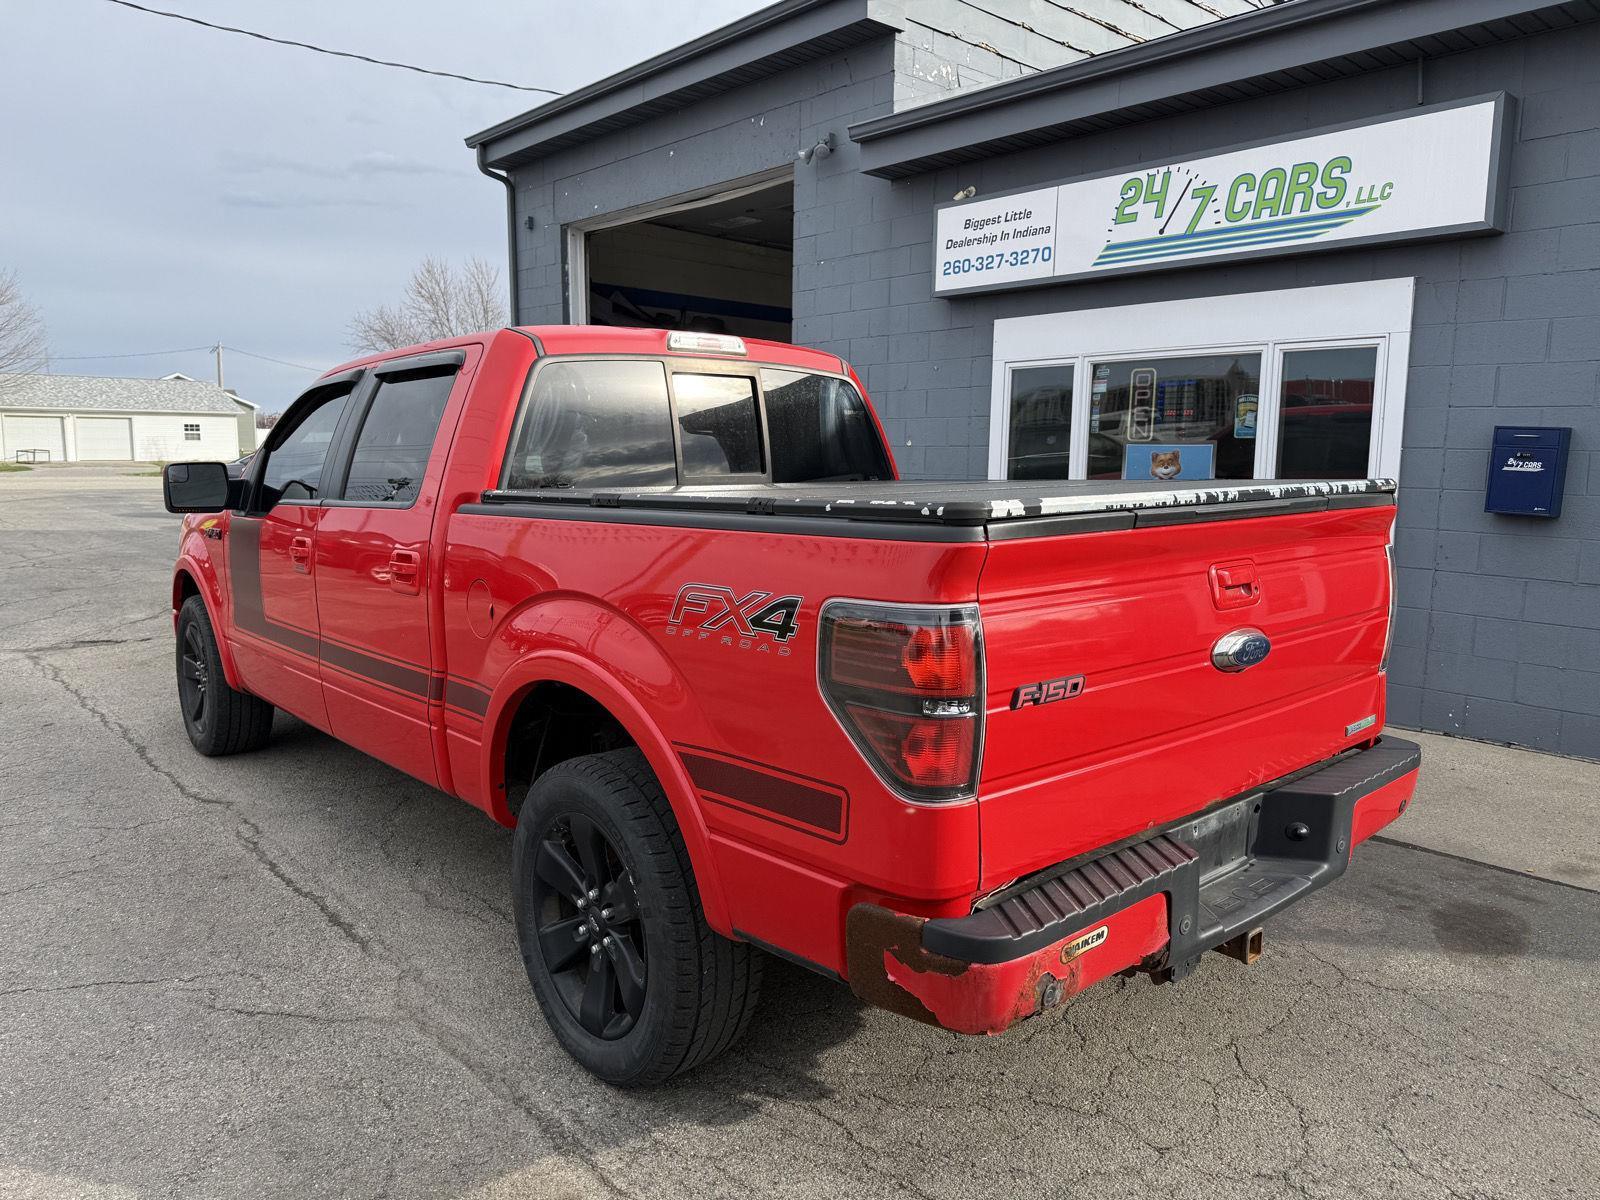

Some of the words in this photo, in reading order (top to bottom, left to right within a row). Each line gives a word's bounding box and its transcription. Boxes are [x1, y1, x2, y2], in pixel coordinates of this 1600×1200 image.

[1354, 181, 1394, 205] LLC
[963, 215, 1002, 231] Biggest
[1004, 208, 1033, 223] Little
[945, 232, 998, 250] Dealership
[1000, 230, 1010, 241] In
[1012, 225, 1051, 240] Indiana
[943, 246, 1052, 276] 260-327-3270
[1133, 373, 1152, 438] OPEN
[667, 582, 804, 644] FX4
[1011, 675, 1085, 709] F-150
